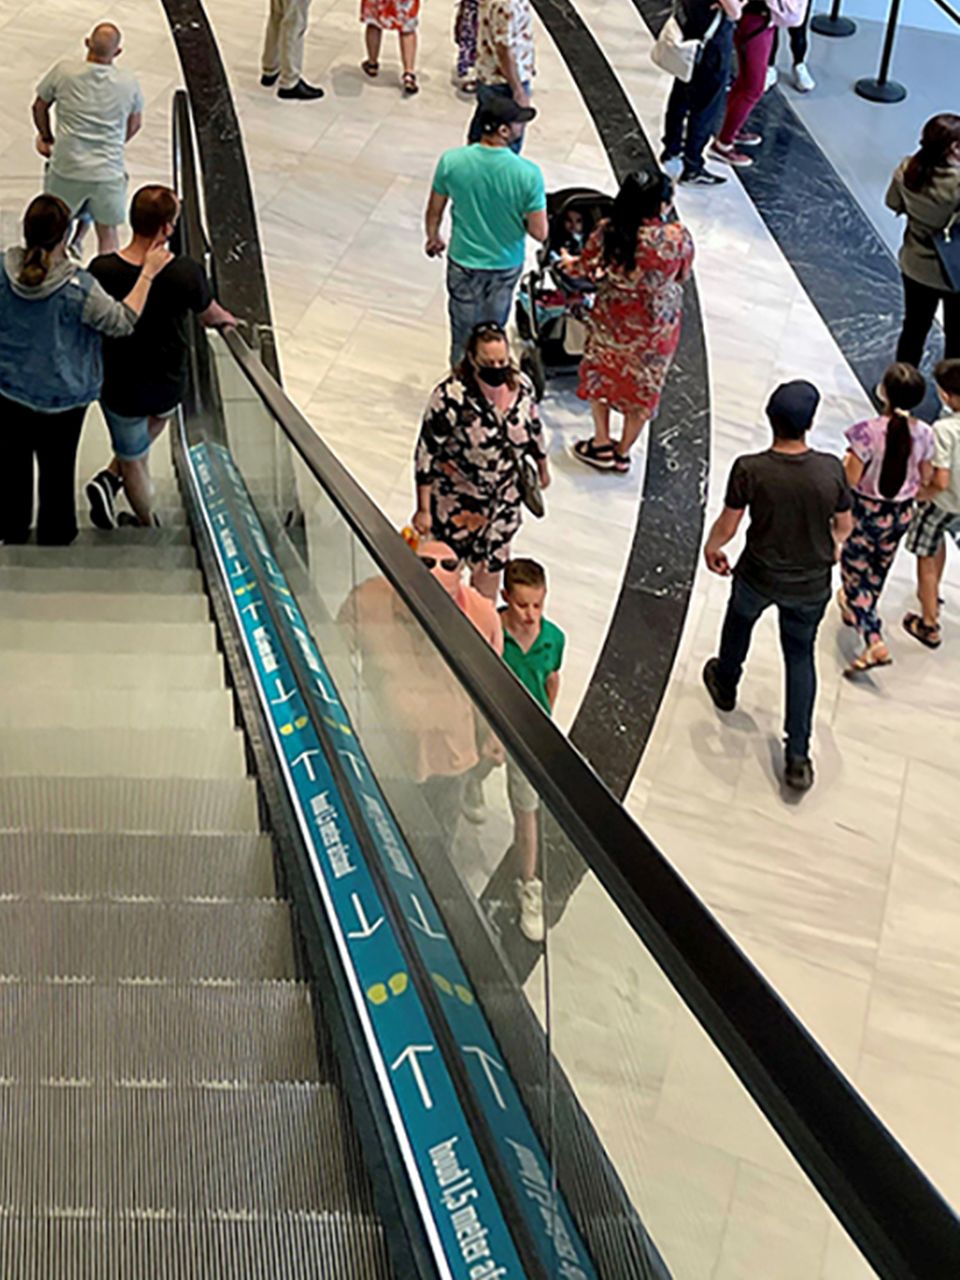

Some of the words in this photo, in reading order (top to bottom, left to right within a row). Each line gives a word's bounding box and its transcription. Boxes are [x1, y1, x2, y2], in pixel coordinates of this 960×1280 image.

[428, 1136, 471, 1188] houd
[440, 1176, 479, 1211] 1,5
[450, 1204, 490, 1264] meter
